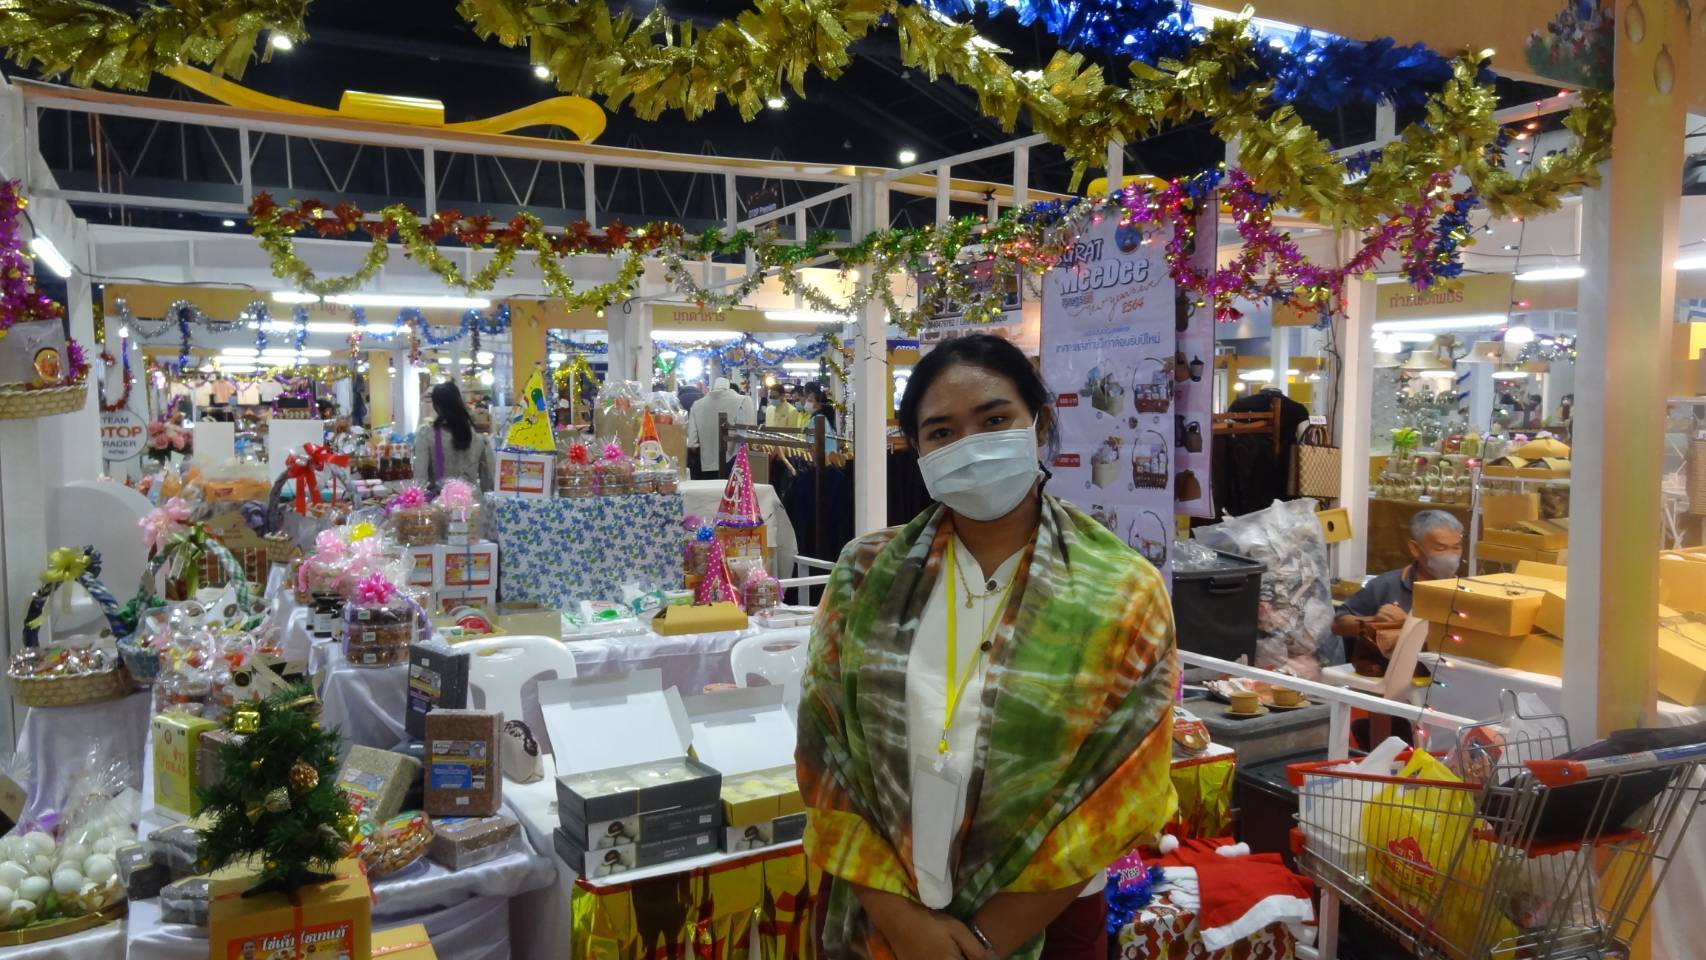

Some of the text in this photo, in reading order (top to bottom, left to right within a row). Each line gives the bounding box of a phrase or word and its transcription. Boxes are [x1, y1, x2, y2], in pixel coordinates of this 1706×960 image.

[673, 311, 726, 325] มุกดาหาร
[102, 416, 129, 425] TEAM
[100, 426, 142, 439] TOP
[102, 440, 137, 448] RADER
